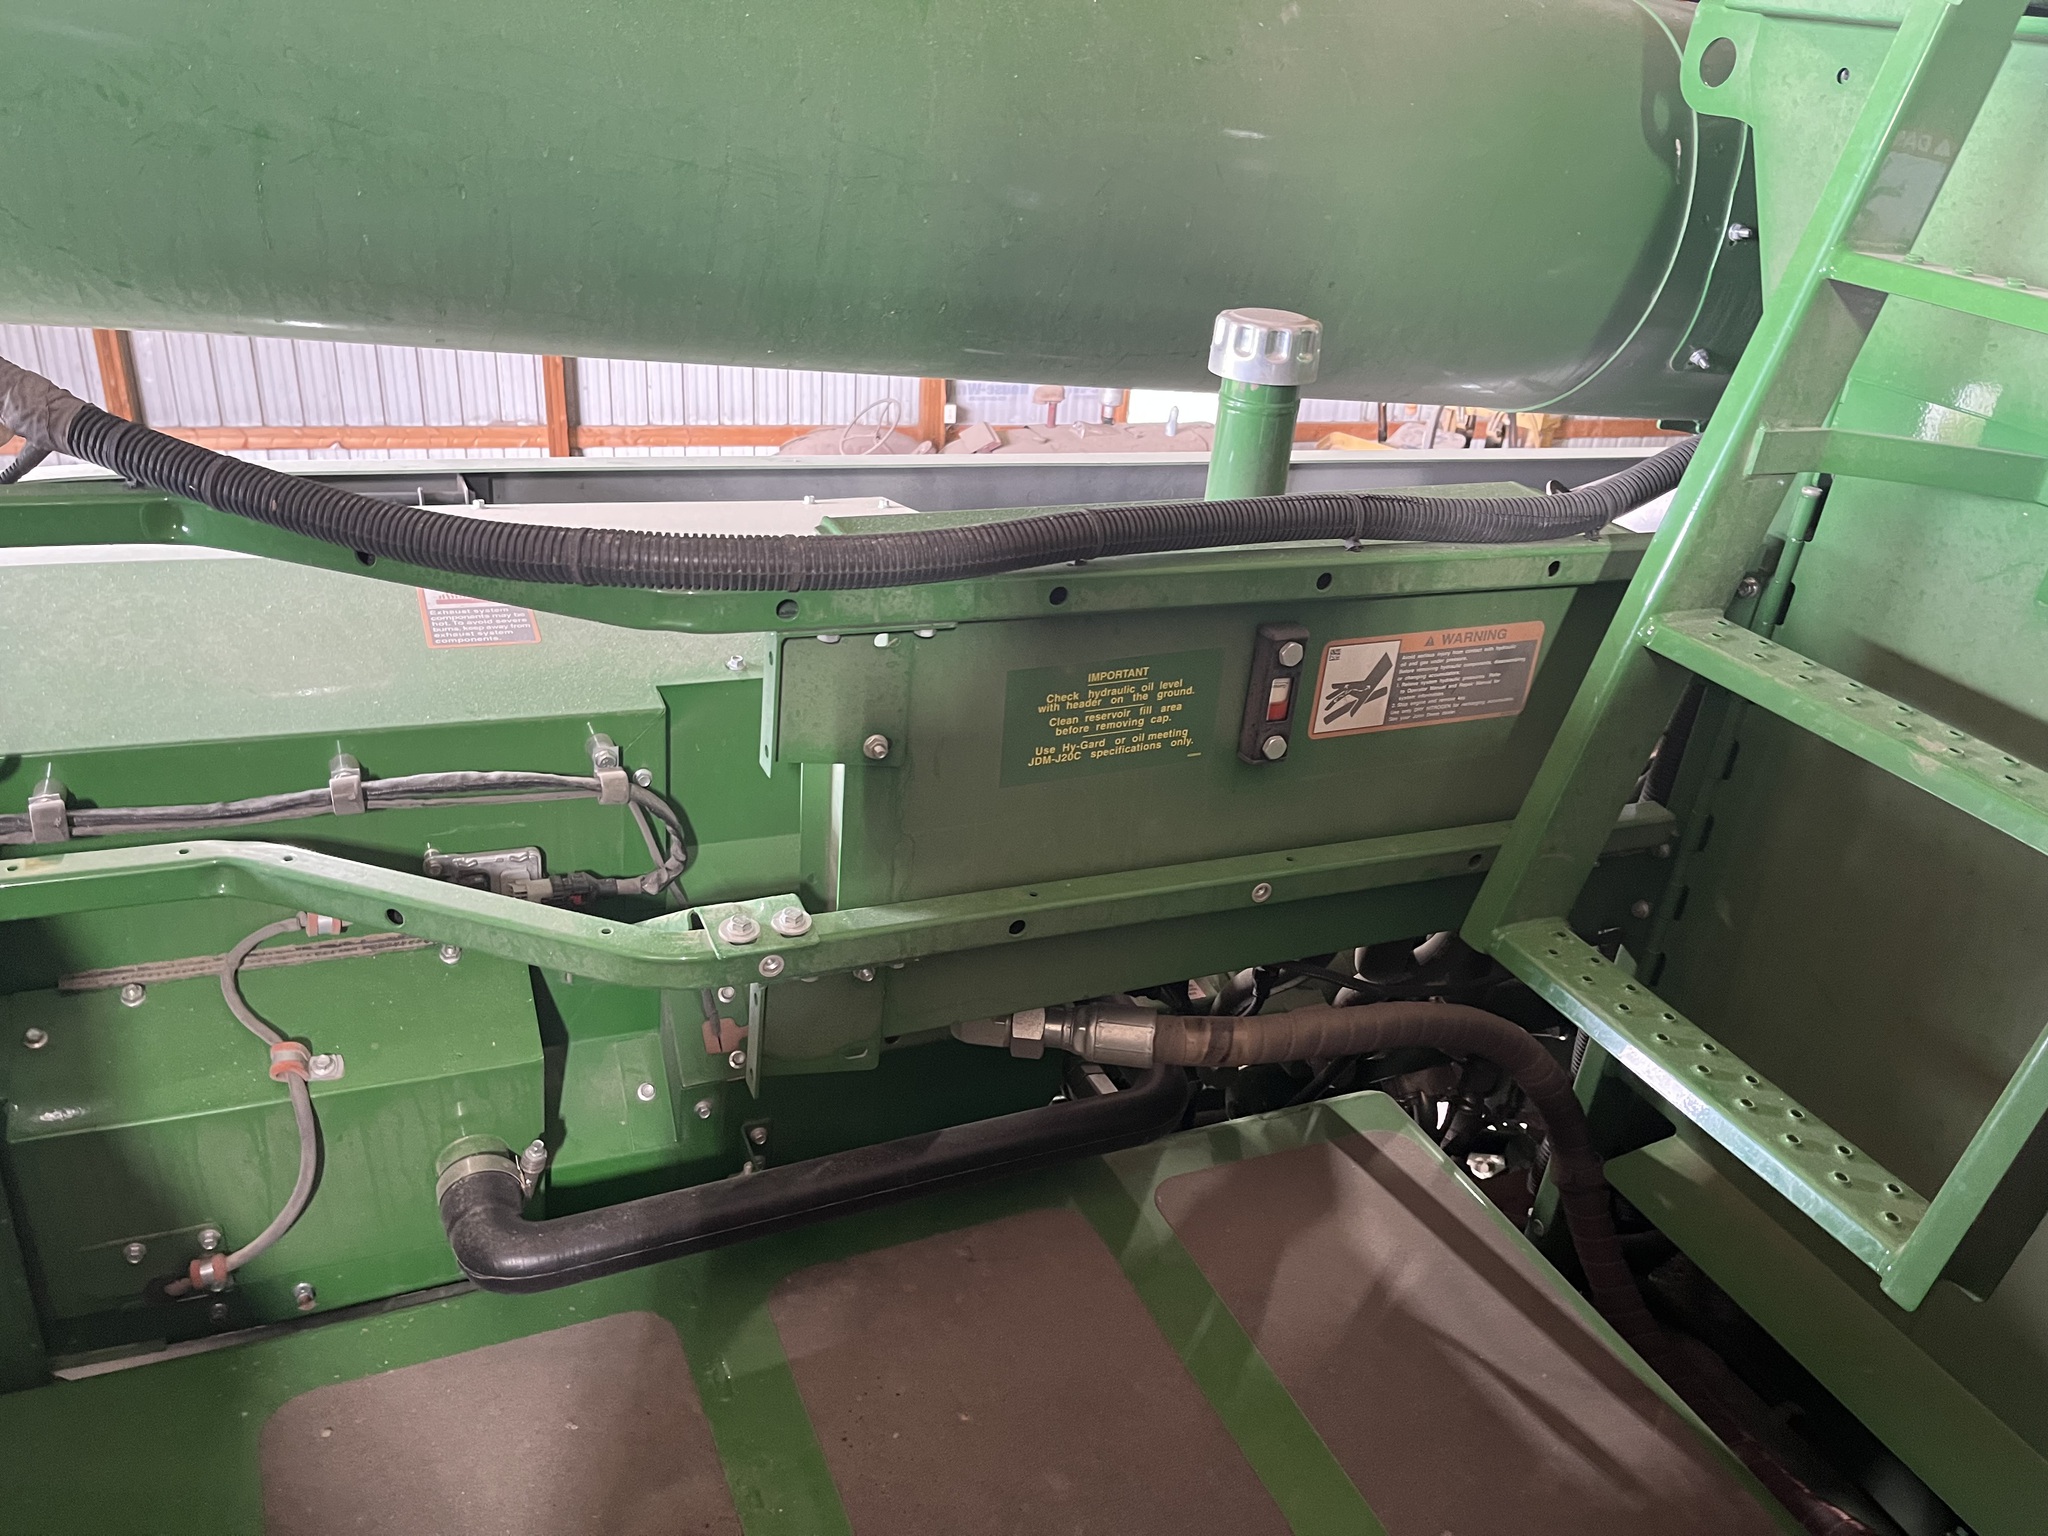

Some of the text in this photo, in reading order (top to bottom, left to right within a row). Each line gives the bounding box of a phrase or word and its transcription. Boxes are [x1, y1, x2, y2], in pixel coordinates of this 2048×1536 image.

[431, 613, 490, 621] components
[435, 636, 501, 644] components.
[1442, 628, 1507, 645] WARNING
[1088, 667, 1149, 683] IMPORTANT
[1038, 686, 1195, 714] with header on the ground.
[1046, 679, 1183, 703] Check hydraulic oil level
[1049, 703, 1183, 727] Clean reservoir fill area
[1055, 714, 1172, 736] before removing cap.
[1028, 736, 1194, 767] JDM-J20C specifications only.
[1035, 729, 1188, 756] Use Hy-Gard or oil meeting
